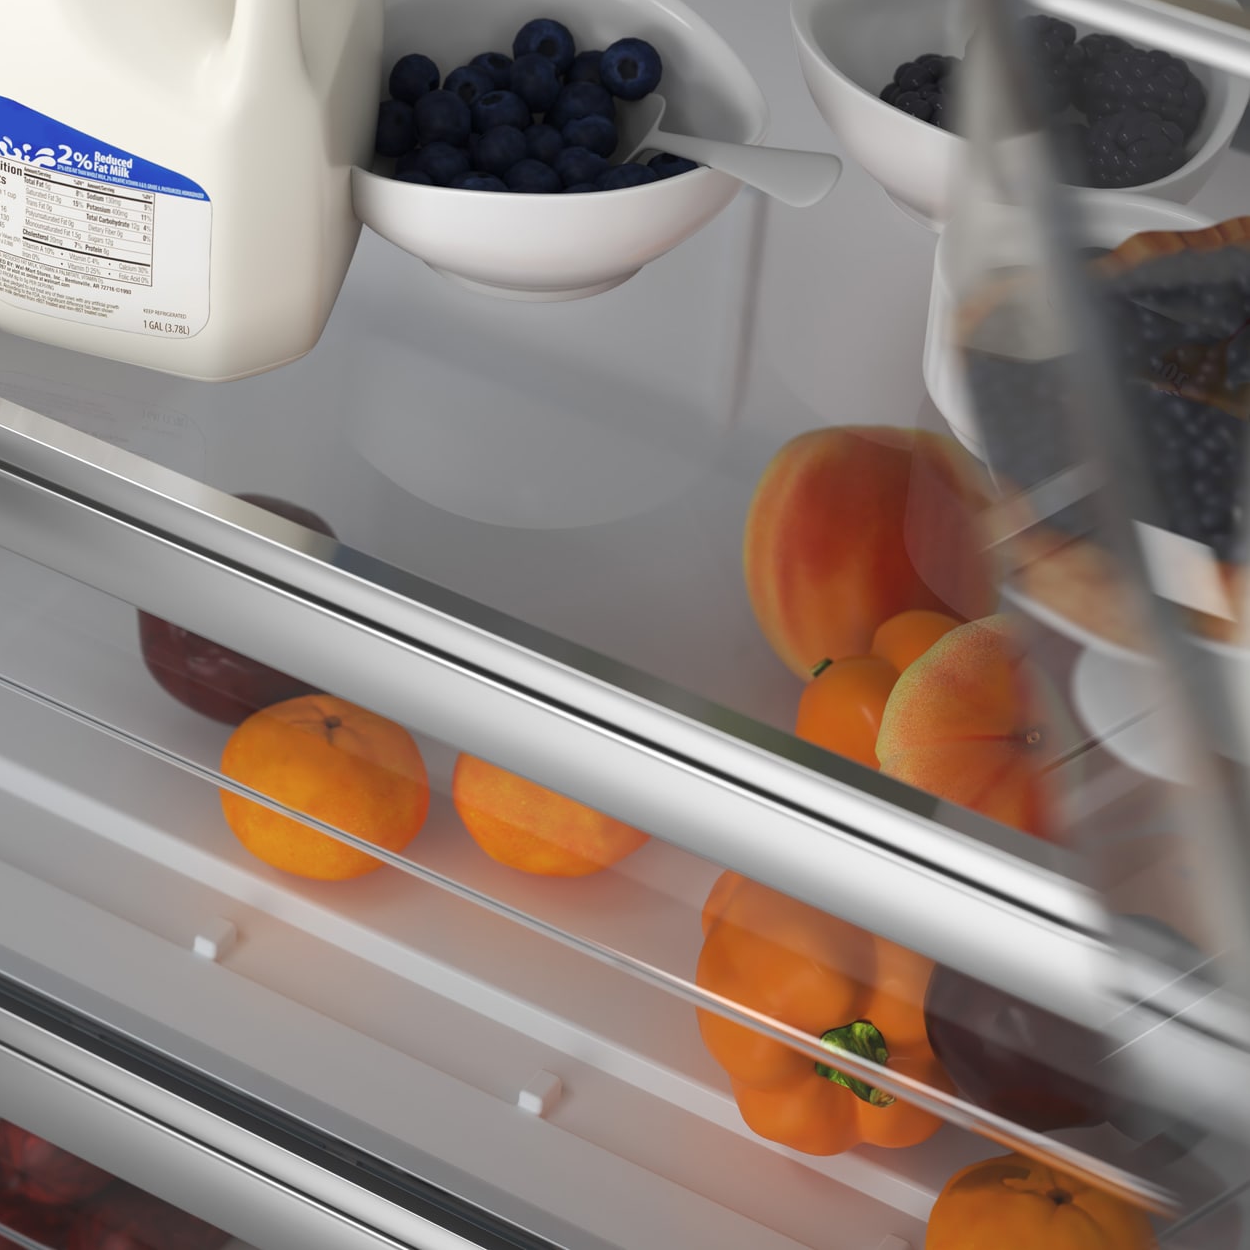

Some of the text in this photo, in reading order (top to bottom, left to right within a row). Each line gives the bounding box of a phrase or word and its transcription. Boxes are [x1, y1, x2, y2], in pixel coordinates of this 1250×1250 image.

[57, 144, 93, 170] 2%
[94, 151, 133, 168] Reduced
[94, 162, 108, 174] Fat
[110, 166, 130, 178] Milk
[24, 177, 35, 185] Total
[87, 192, 104, 202] Sodium
[86, 203, 110, 214] Potassium
[86, 213, 130, 228] Total Carbohydrate
[23, 229, 48, 240] Cholesterol
[85, 244, 102, 253] Protein
[155, 310, 187, 319] REFRIGERATED
[144, 320, 190, 335] 1 GAL (3.78L)
